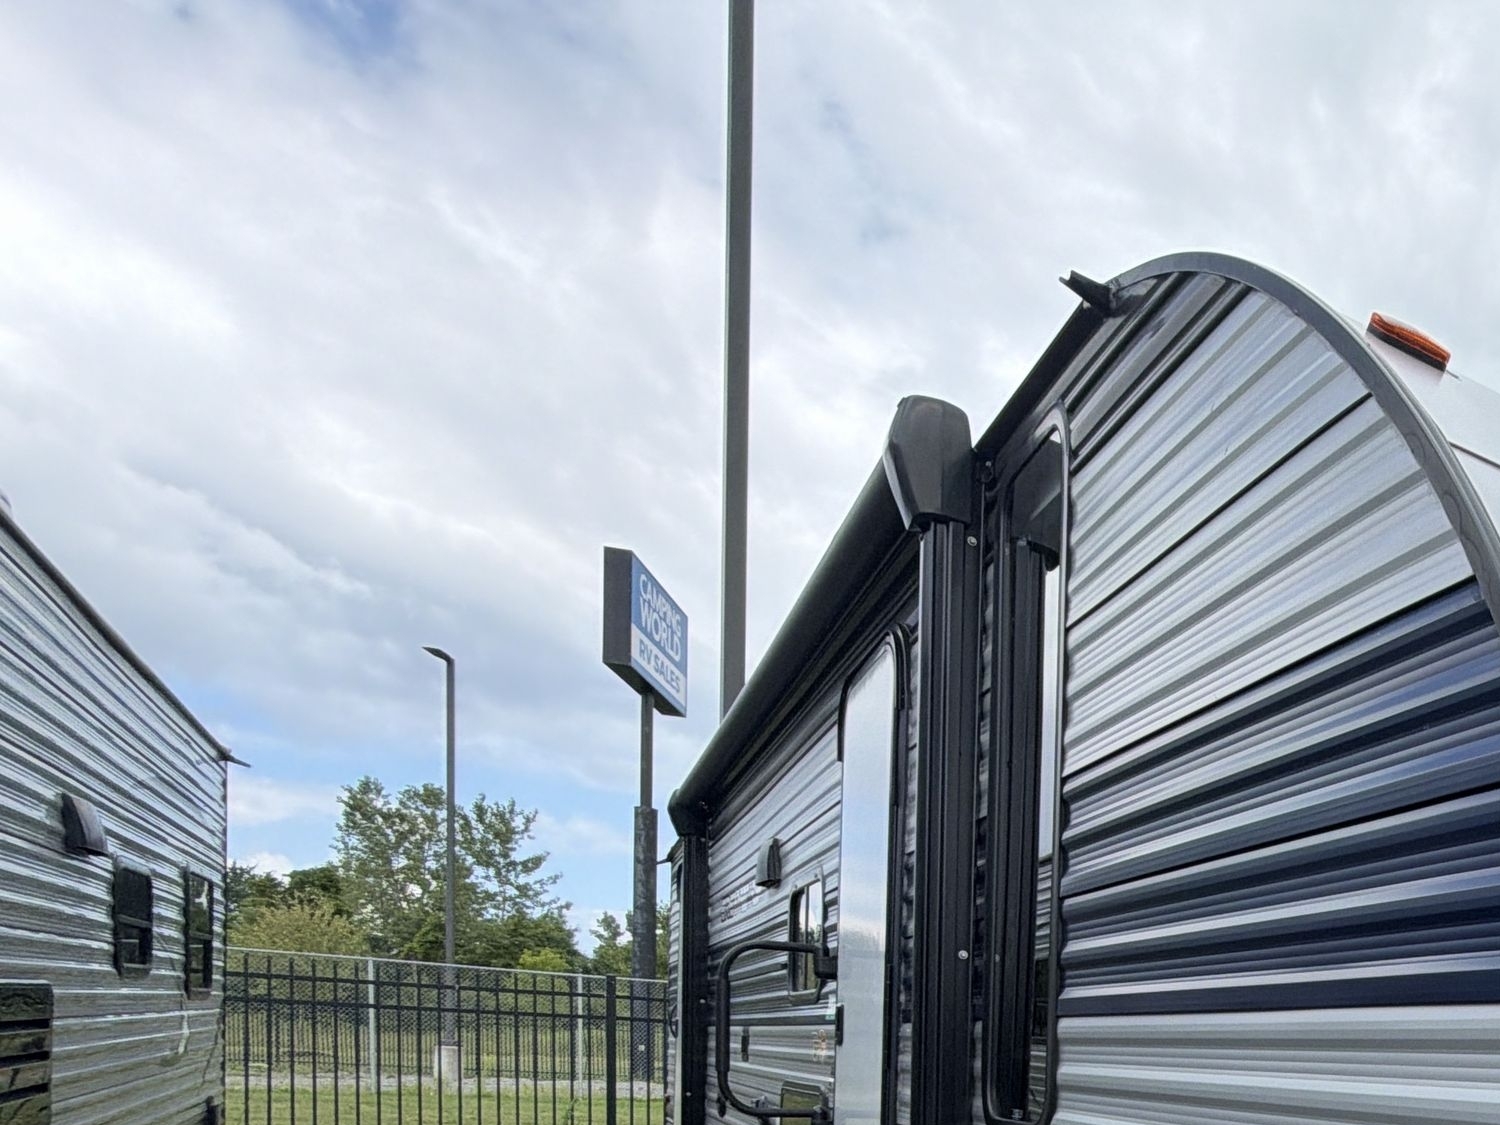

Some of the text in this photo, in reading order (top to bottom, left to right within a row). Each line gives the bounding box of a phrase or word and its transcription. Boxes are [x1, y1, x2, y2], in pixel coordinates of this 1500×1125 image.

[639, 573, 682, 638] CAMPING
[639, 596, 682, 663] WORLD
[639, 638, 681, 694] RV SALES
